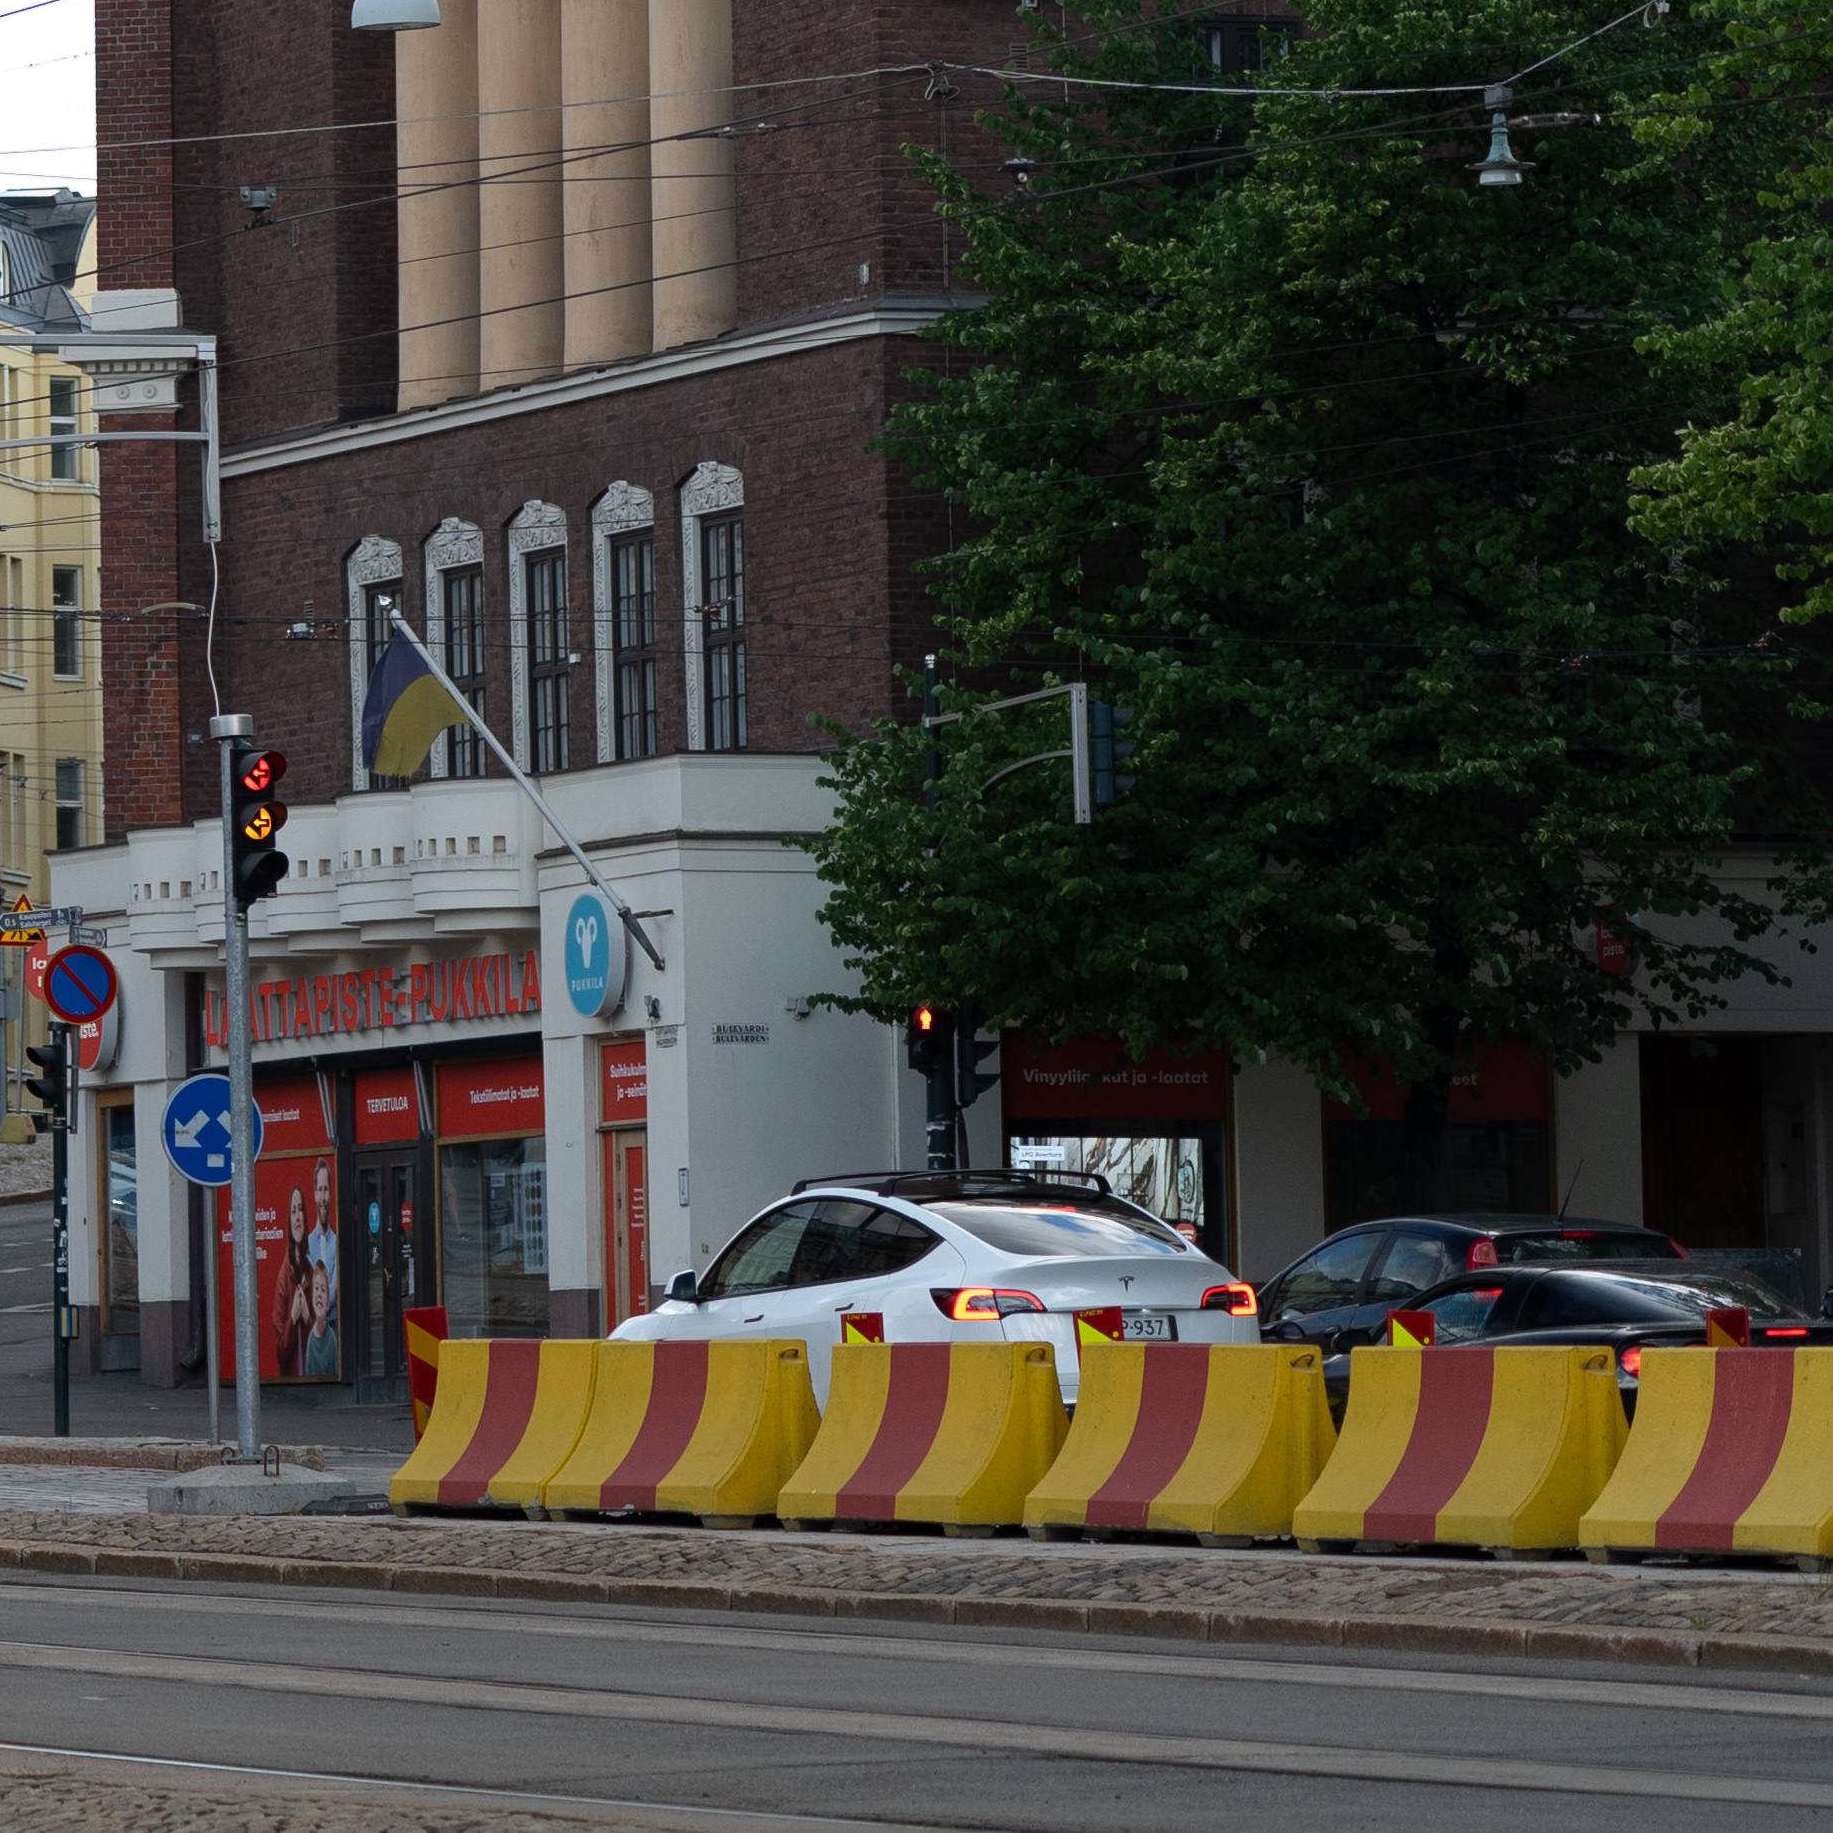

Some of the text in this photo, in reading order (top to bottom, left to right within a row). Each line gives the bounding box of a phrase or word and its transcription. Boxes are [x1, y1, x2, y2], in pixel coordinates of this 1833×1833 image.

[716, 1025, 765, 1033] BULEVARDI
[715, 1034, 766, 1043] BULEVARDEN
[1132, 1071, 1147, 1086] ja
[1152, 1070, 1209, 1084] -laatat
[367, 1096, 409, 1113] TERVETULOA
